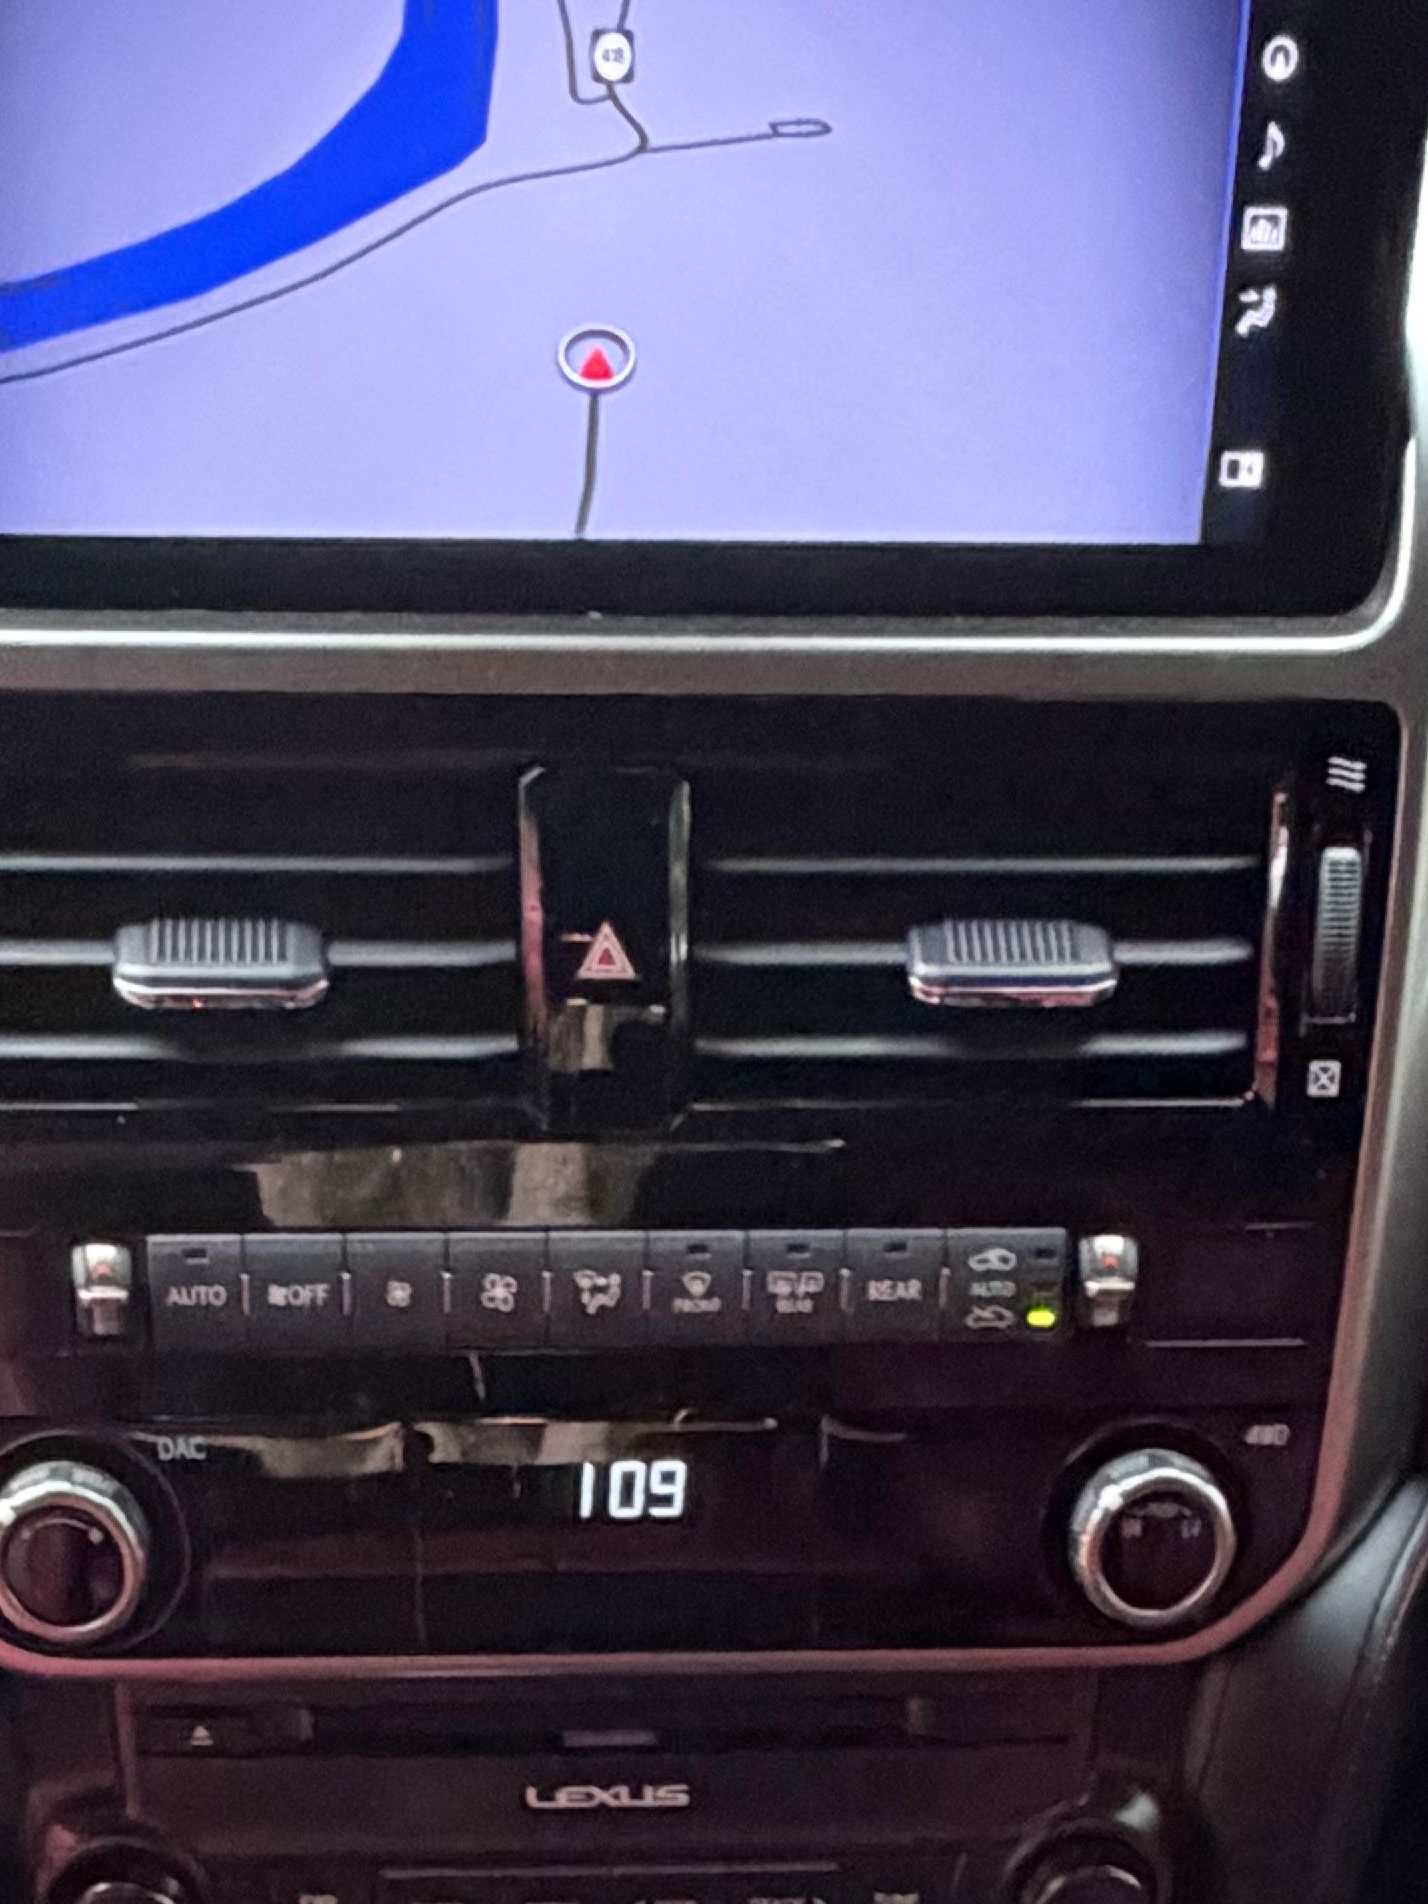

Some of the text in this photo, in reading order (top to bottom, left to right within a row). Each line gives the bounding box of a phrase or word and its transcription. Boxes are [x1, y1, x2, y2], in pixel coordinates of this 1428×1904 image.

[165, 1286, 227, 1308] AUTO
[289, 1283, 329, 1306] OFF
[868, 1279, 922, 1301] REAR
[969, 1281, 1016, 1297] AUTO
[156, 1435, 207, 1461] DAC
[577, 1459, 688, 1519] 109
[525, 1784, 691, 1810] LEXUS
